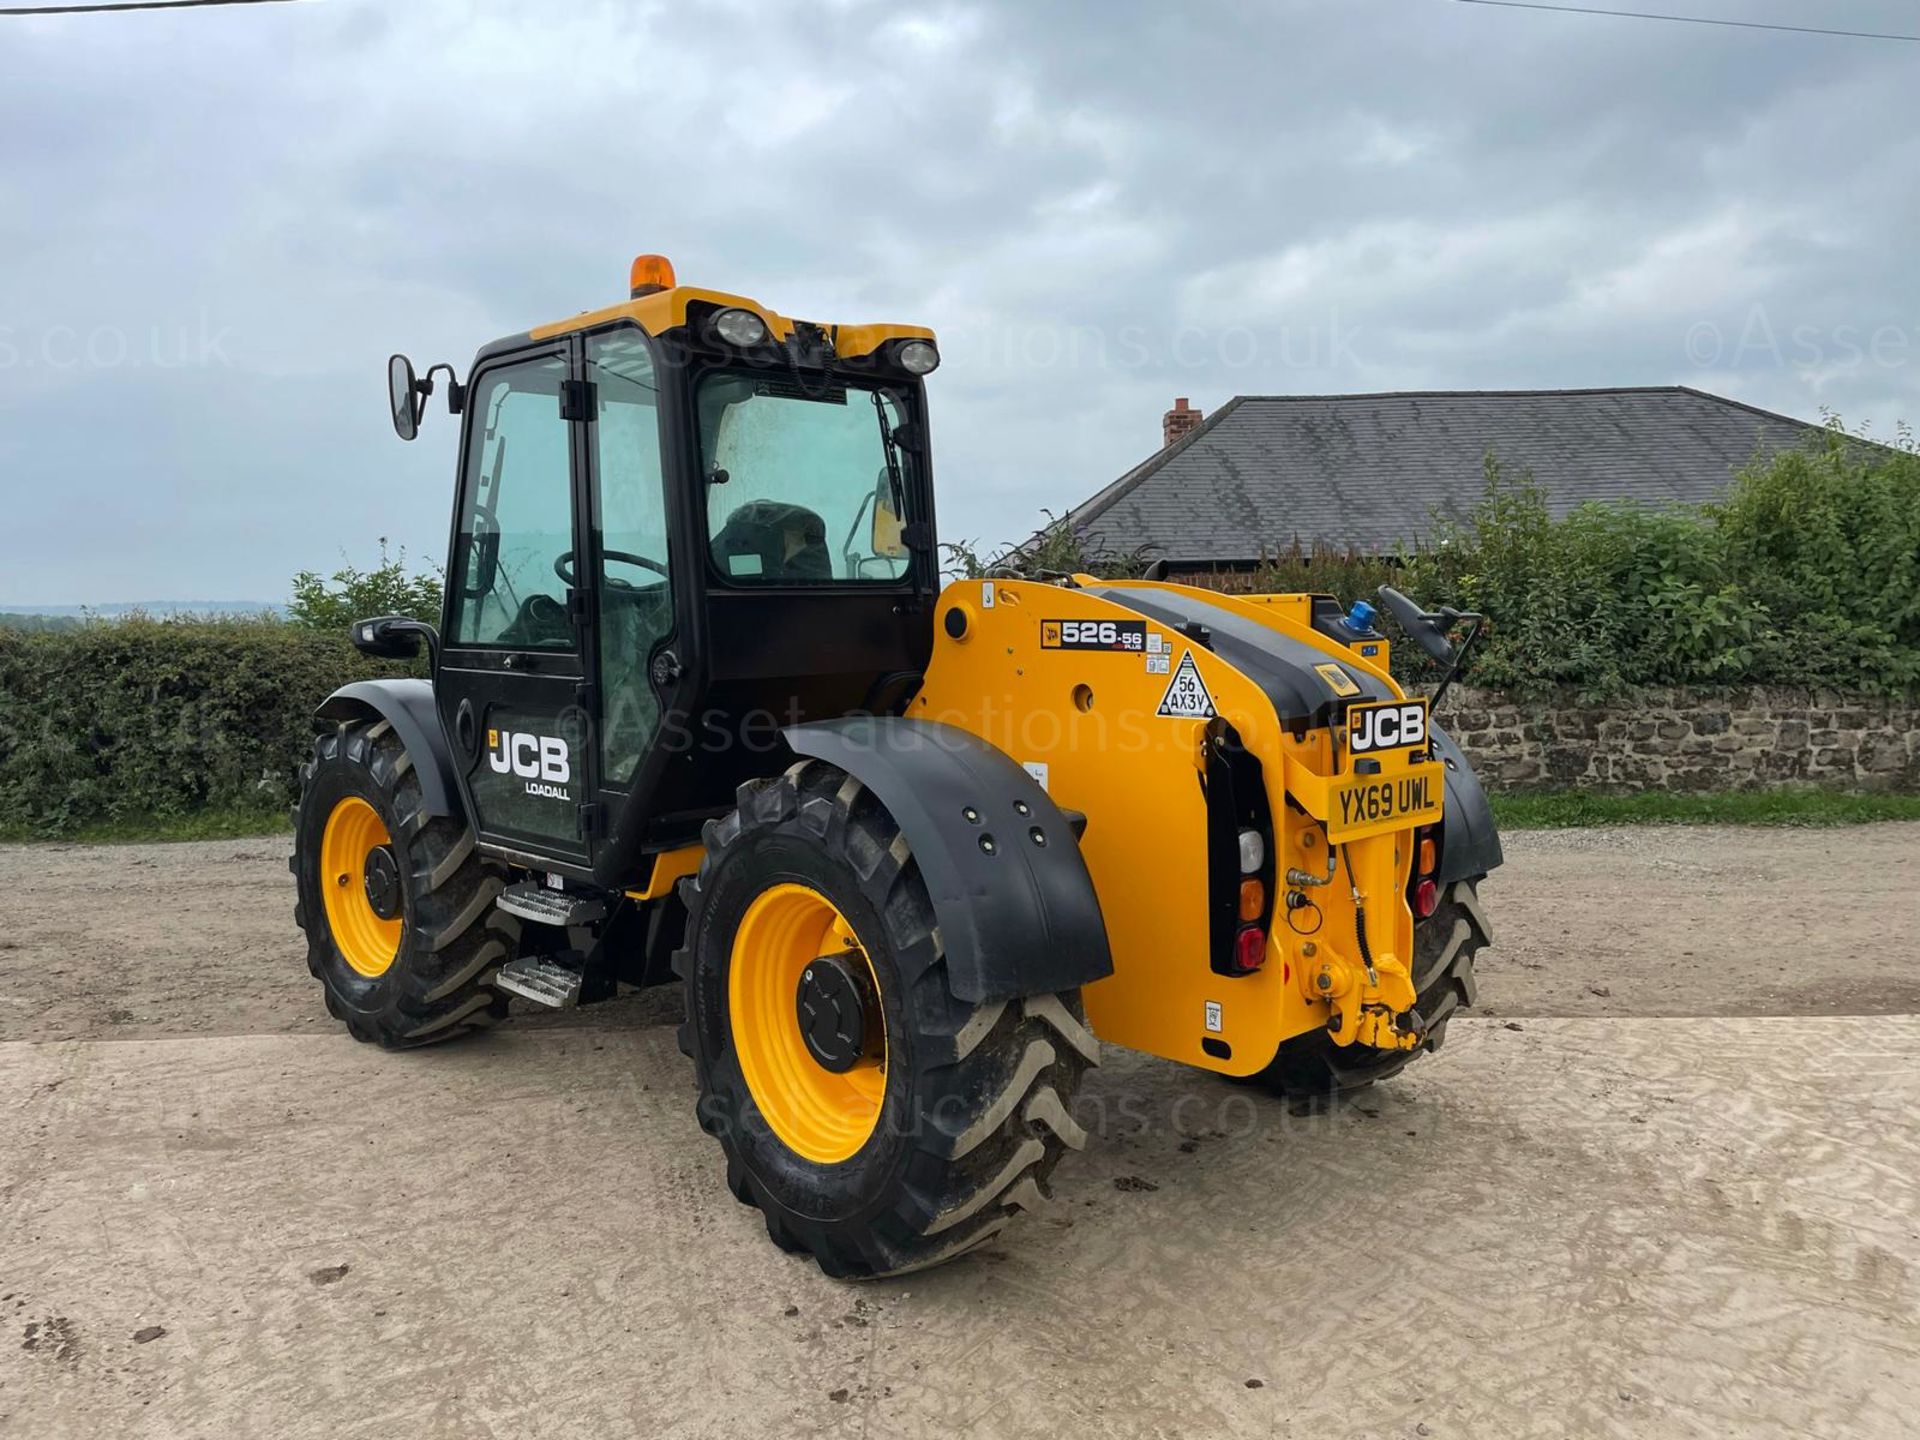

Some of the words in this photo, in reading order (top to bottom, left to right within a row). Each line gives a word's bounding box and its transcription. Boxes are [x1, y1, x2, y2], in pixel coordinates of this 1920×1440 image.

[1179, 676, 1195, 692] 56
[1352, 706, 1424, 750] JCB
[490, 731, 570, 783] JCB
[525, 782, 571, 801] LOADALL
[1340, 783, 1392, 824] YX69
[1399, 776, 1434, 813] UWL
